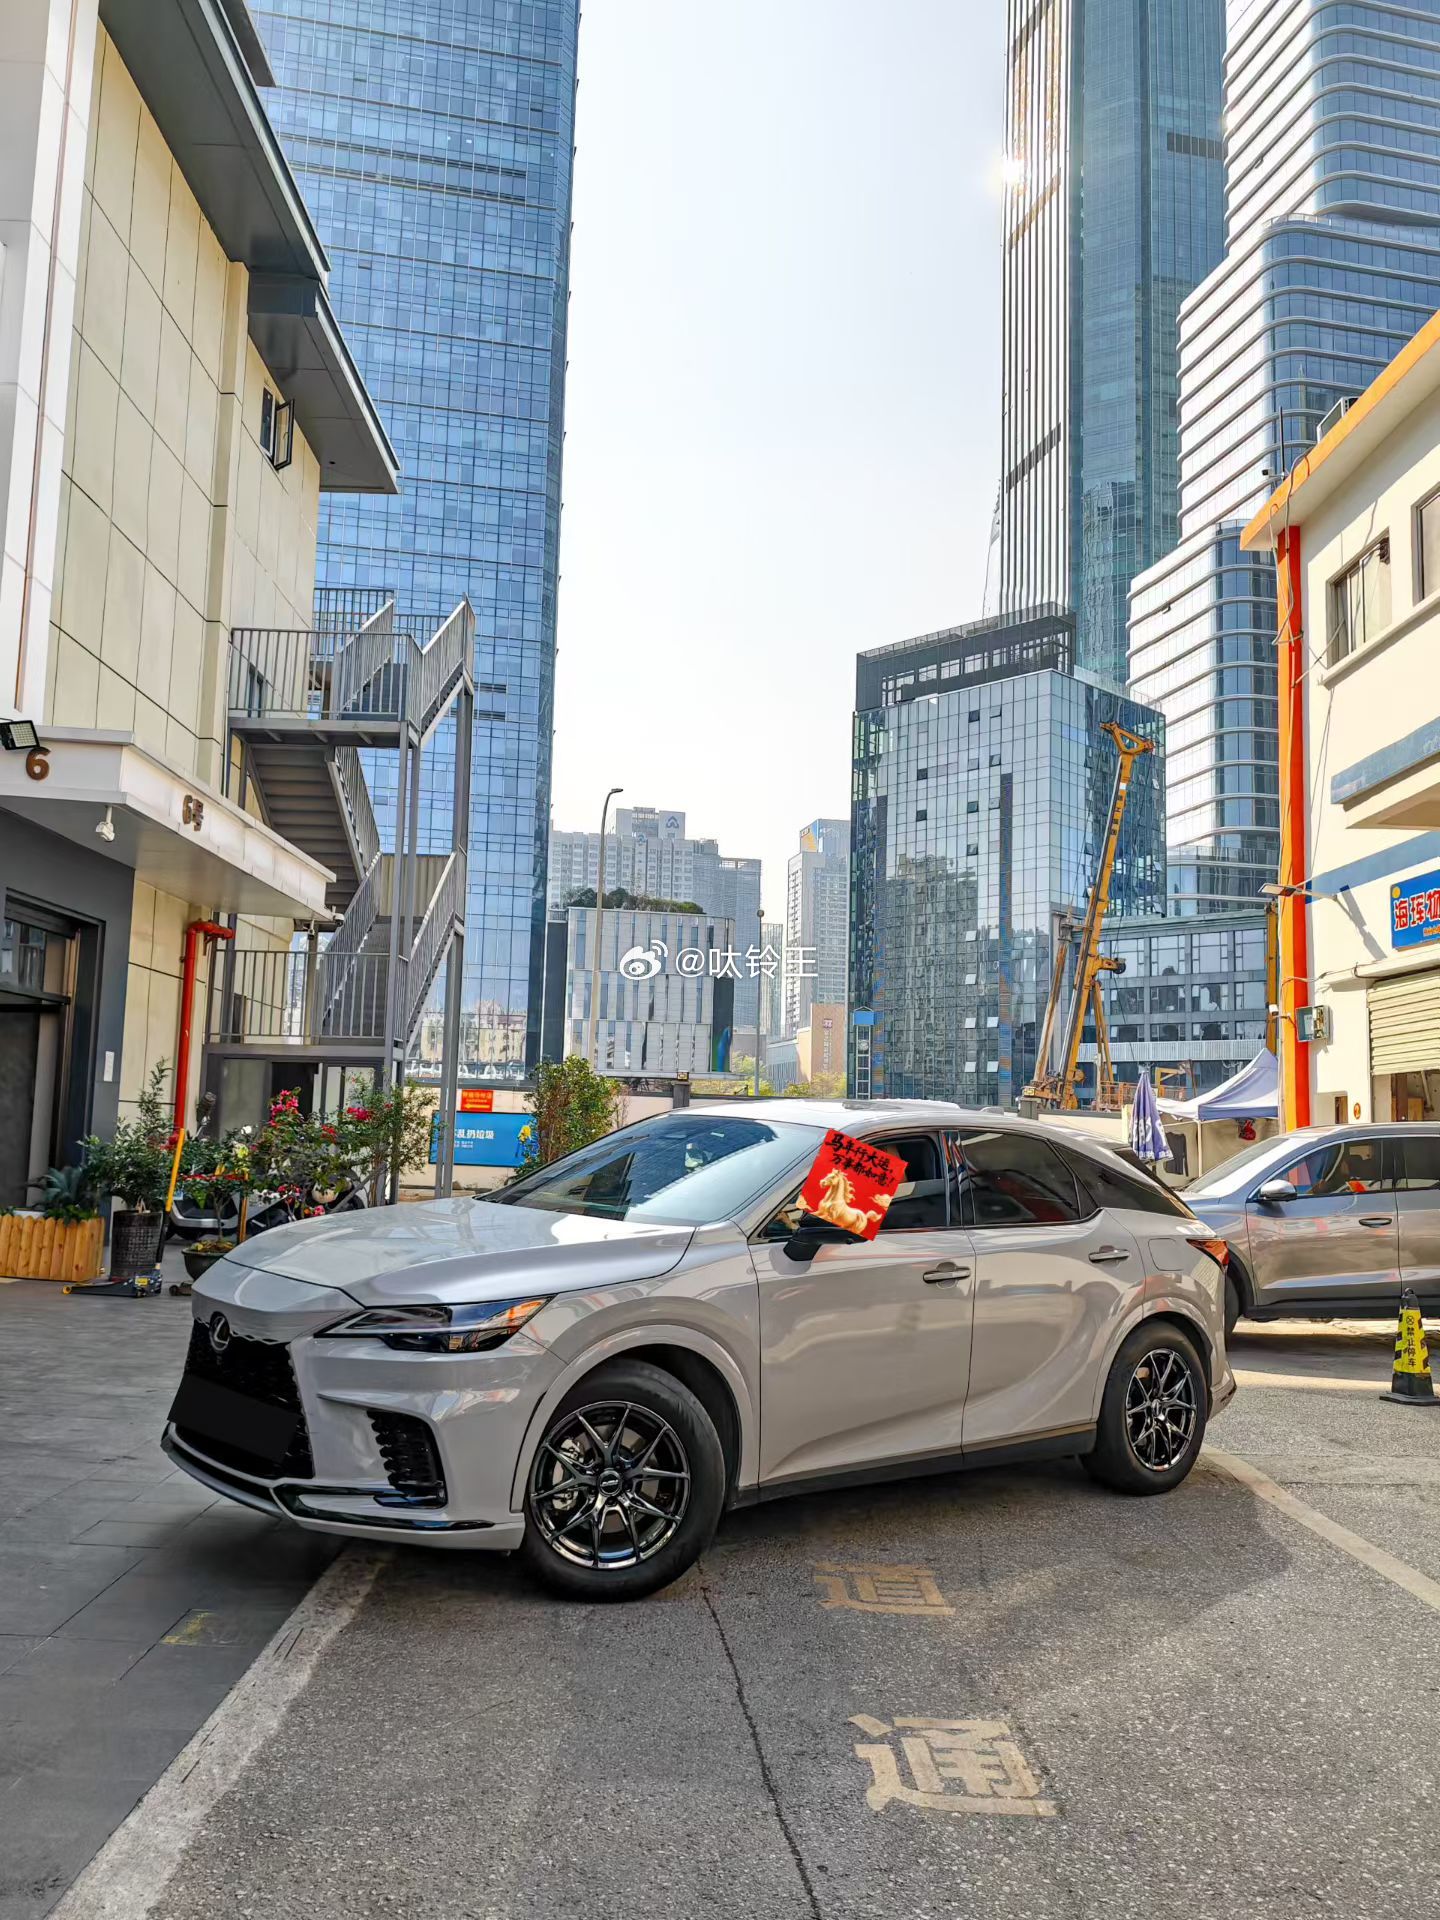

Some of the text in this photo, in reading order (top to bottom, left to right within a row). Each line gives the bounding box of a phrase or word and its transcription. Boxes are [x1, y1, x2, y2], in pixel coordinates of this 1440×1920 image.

[25, 746, 51, 781] 6
[182, 794, 204, 832] 6号
[1406, 1326, 1417, 1367] 禁止停车
